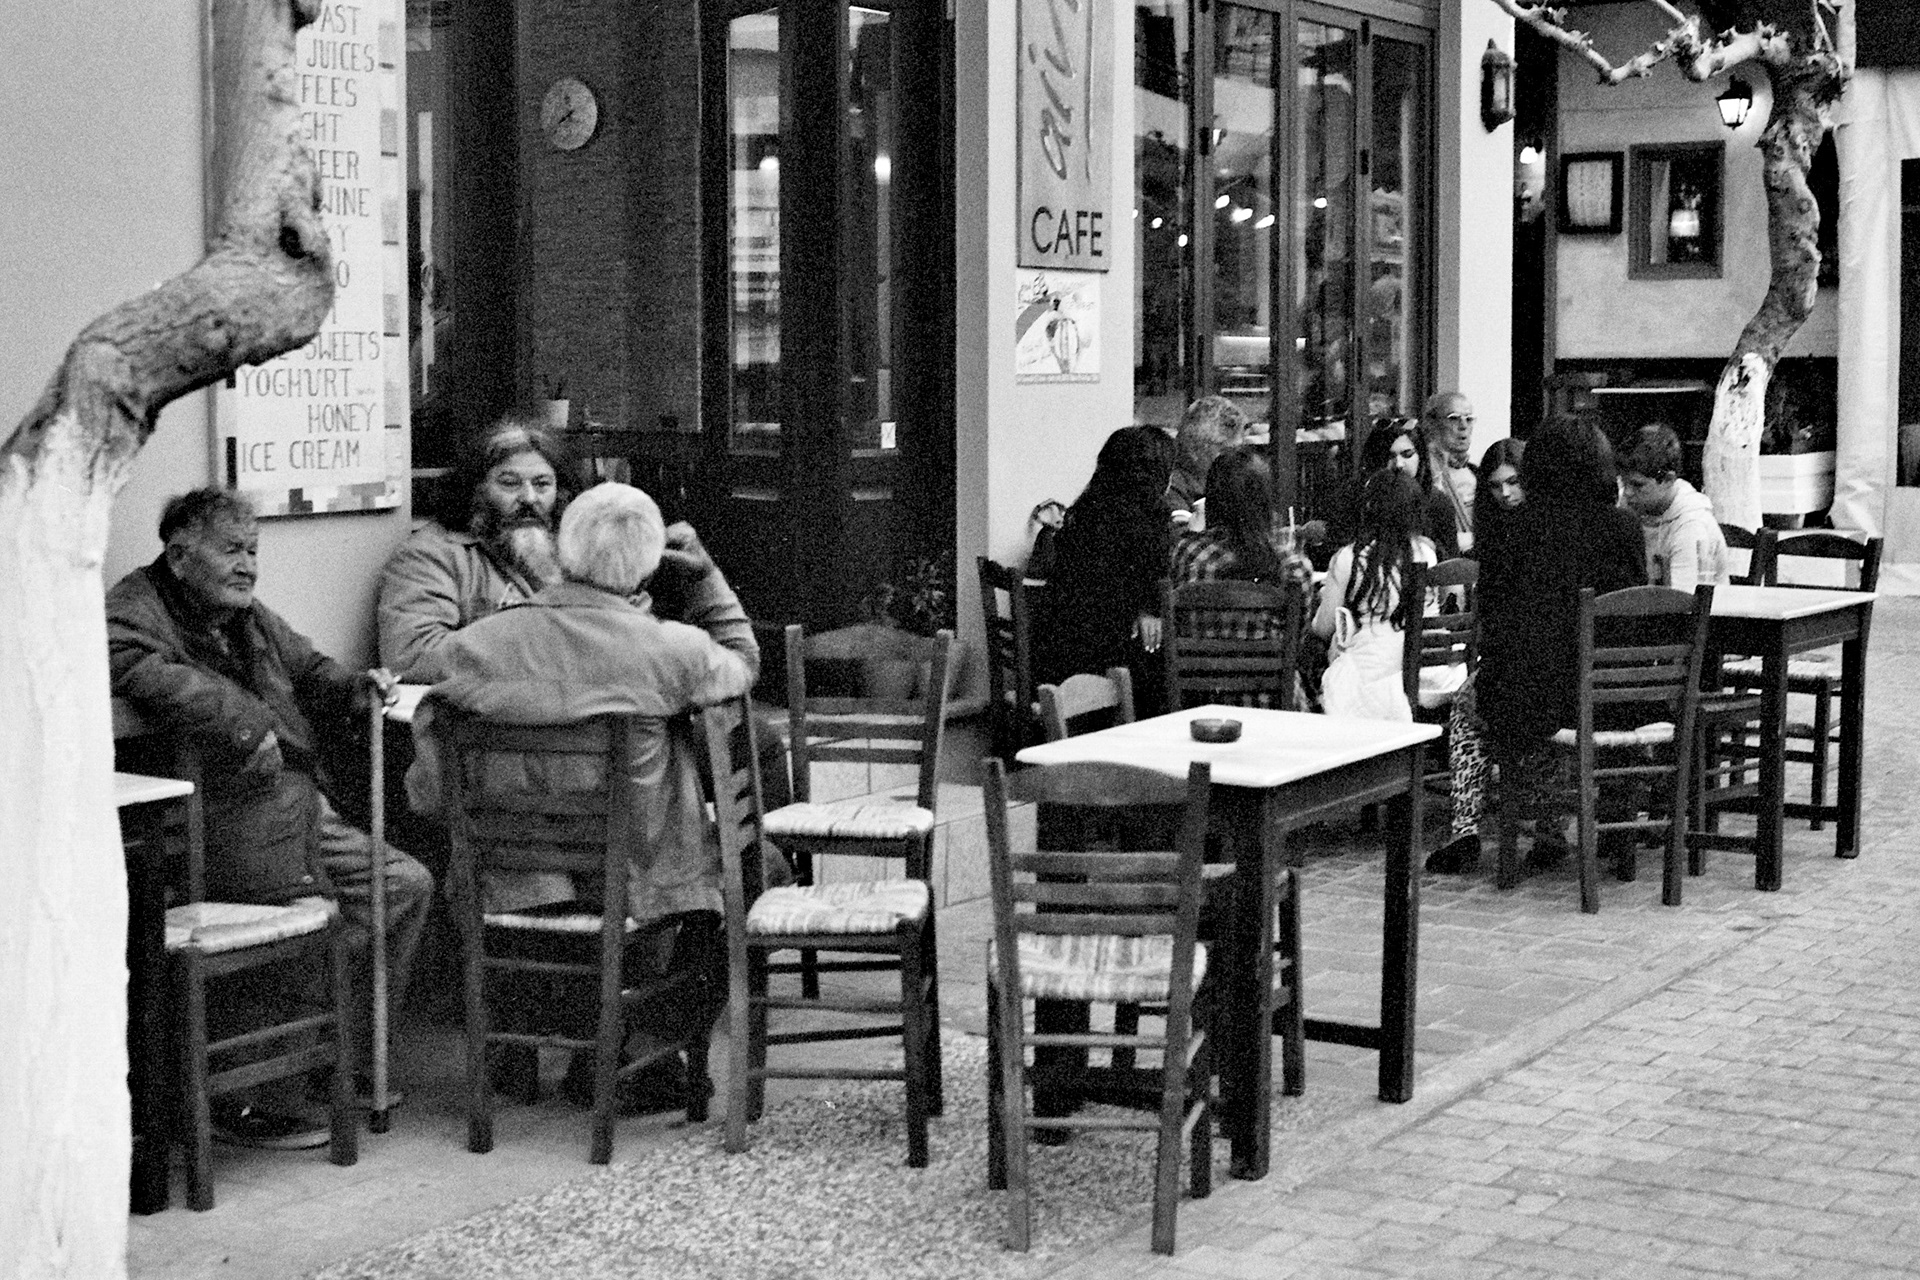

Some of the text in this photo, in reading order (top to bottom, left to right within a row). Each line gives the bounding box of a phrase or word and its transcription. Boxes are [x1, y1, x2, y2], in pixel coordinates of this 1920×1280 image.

[320, 4, 362, 35] AST
[306, 38, 375, 73] JUICES
[301, 73, 358, 107] FEES
[301, 111, 342, 142] GHT
[1031, 206, 1103, 257] CAFE
[240, 367, 353, 398] YOGHURT
[307, 402, 377, 433] HONEY
[241, 438, 361, 473] ICE CREAM
